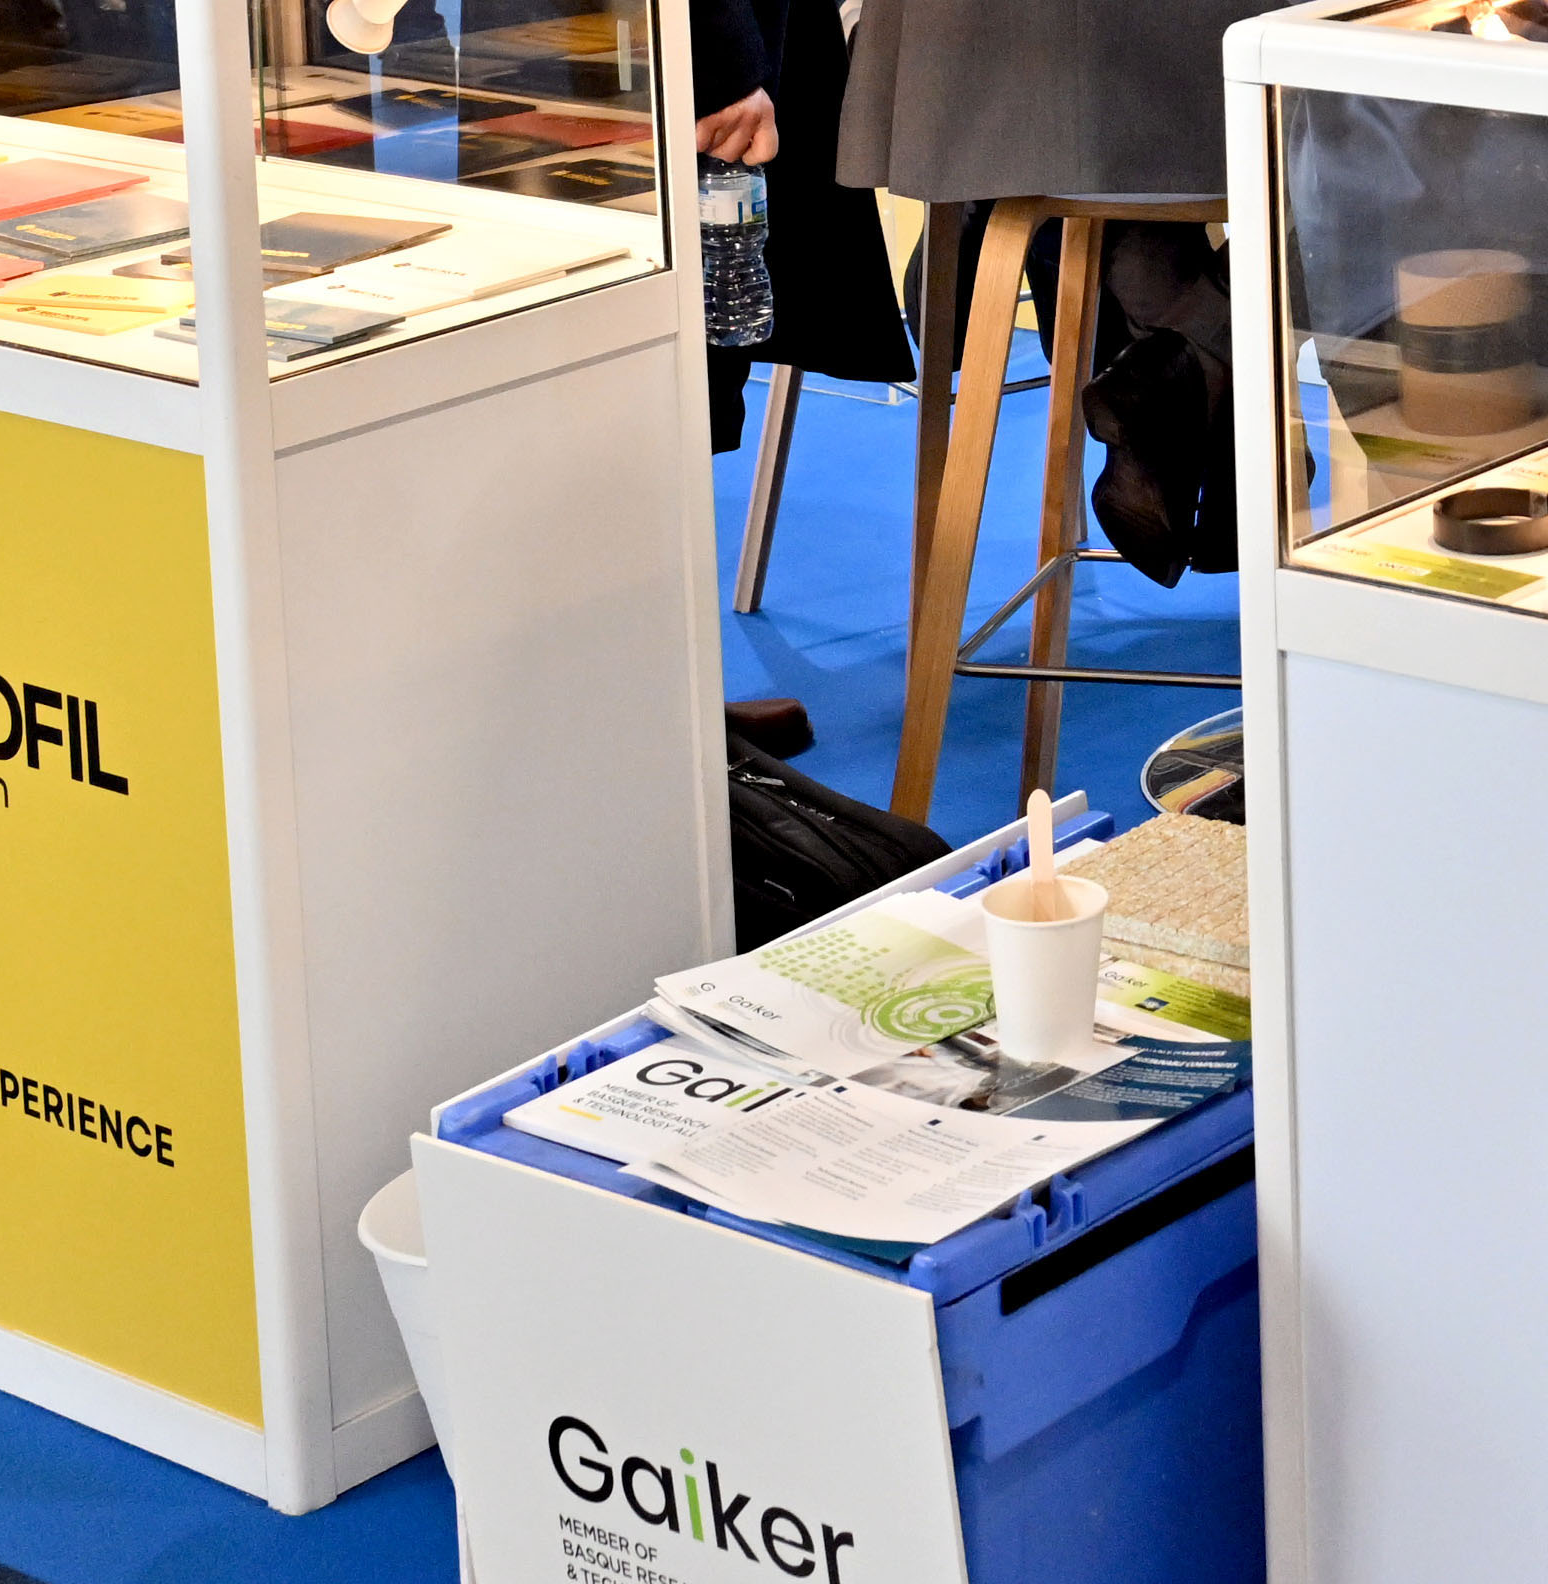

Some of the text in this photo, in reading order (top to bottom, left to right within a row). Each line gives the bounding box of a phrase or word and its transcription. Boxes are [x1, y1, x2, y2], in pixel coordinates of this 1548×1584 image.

[547, 1415, 854, 1584] Gaiker
[559, 1514, 658, 1562] MEMBER OF
[563, 1538, 633, 1579] BASQUE
